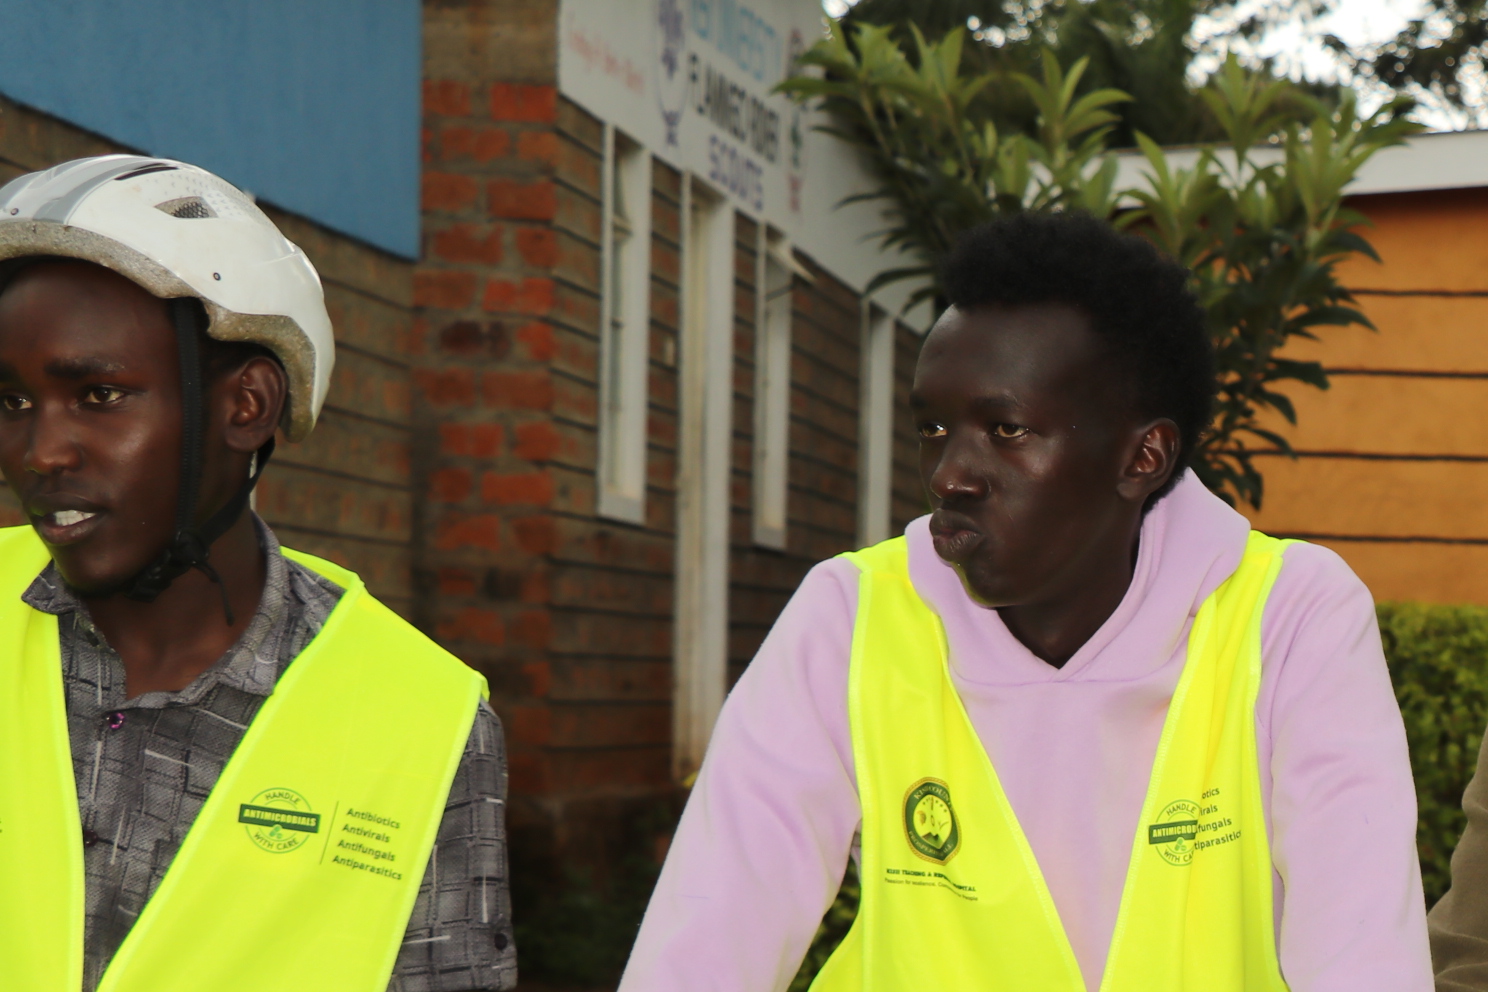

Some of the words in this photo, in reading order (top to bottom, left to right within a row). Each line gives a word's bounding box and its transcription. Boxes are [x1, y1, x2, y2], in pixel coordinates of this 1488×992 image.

[265, 791, 301, 805] HANDLE
[243, 809, 317, 827] ANTIMICROBIALS
[346, 807, 400, 829] Antibiotics
[1166, 803, 1197, 817] HANDLE
[253, 832, 274, 850] WITH
[275, 838, 299, 851] CARE
[342, 823, 391, 843] Antivirals
[337, 838, 396, 862] Antifungals
[332, 854, 402, 881] Antiparasitics
